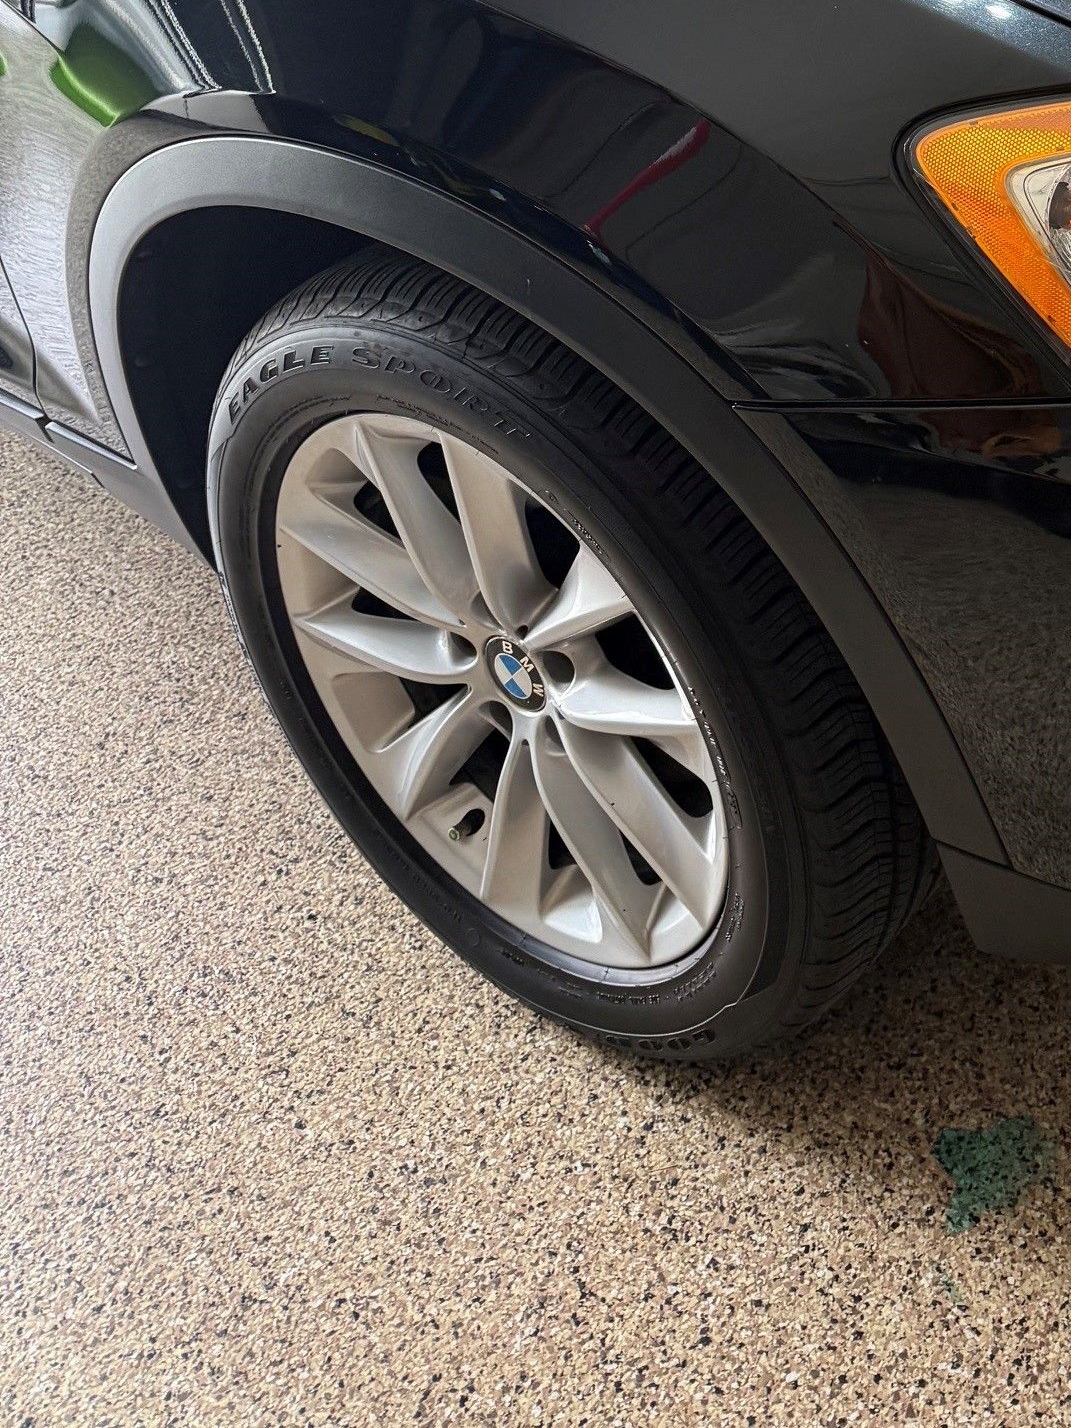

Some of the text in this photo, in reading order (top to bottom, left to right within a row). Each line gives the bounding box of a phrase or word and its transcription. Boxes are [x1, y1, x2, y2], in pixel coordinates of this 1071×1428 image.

[228, 345, 334, 424] EAGLE
[351, 346, 531, 438] SPORT
[502, 640, 544, 697] BMW
